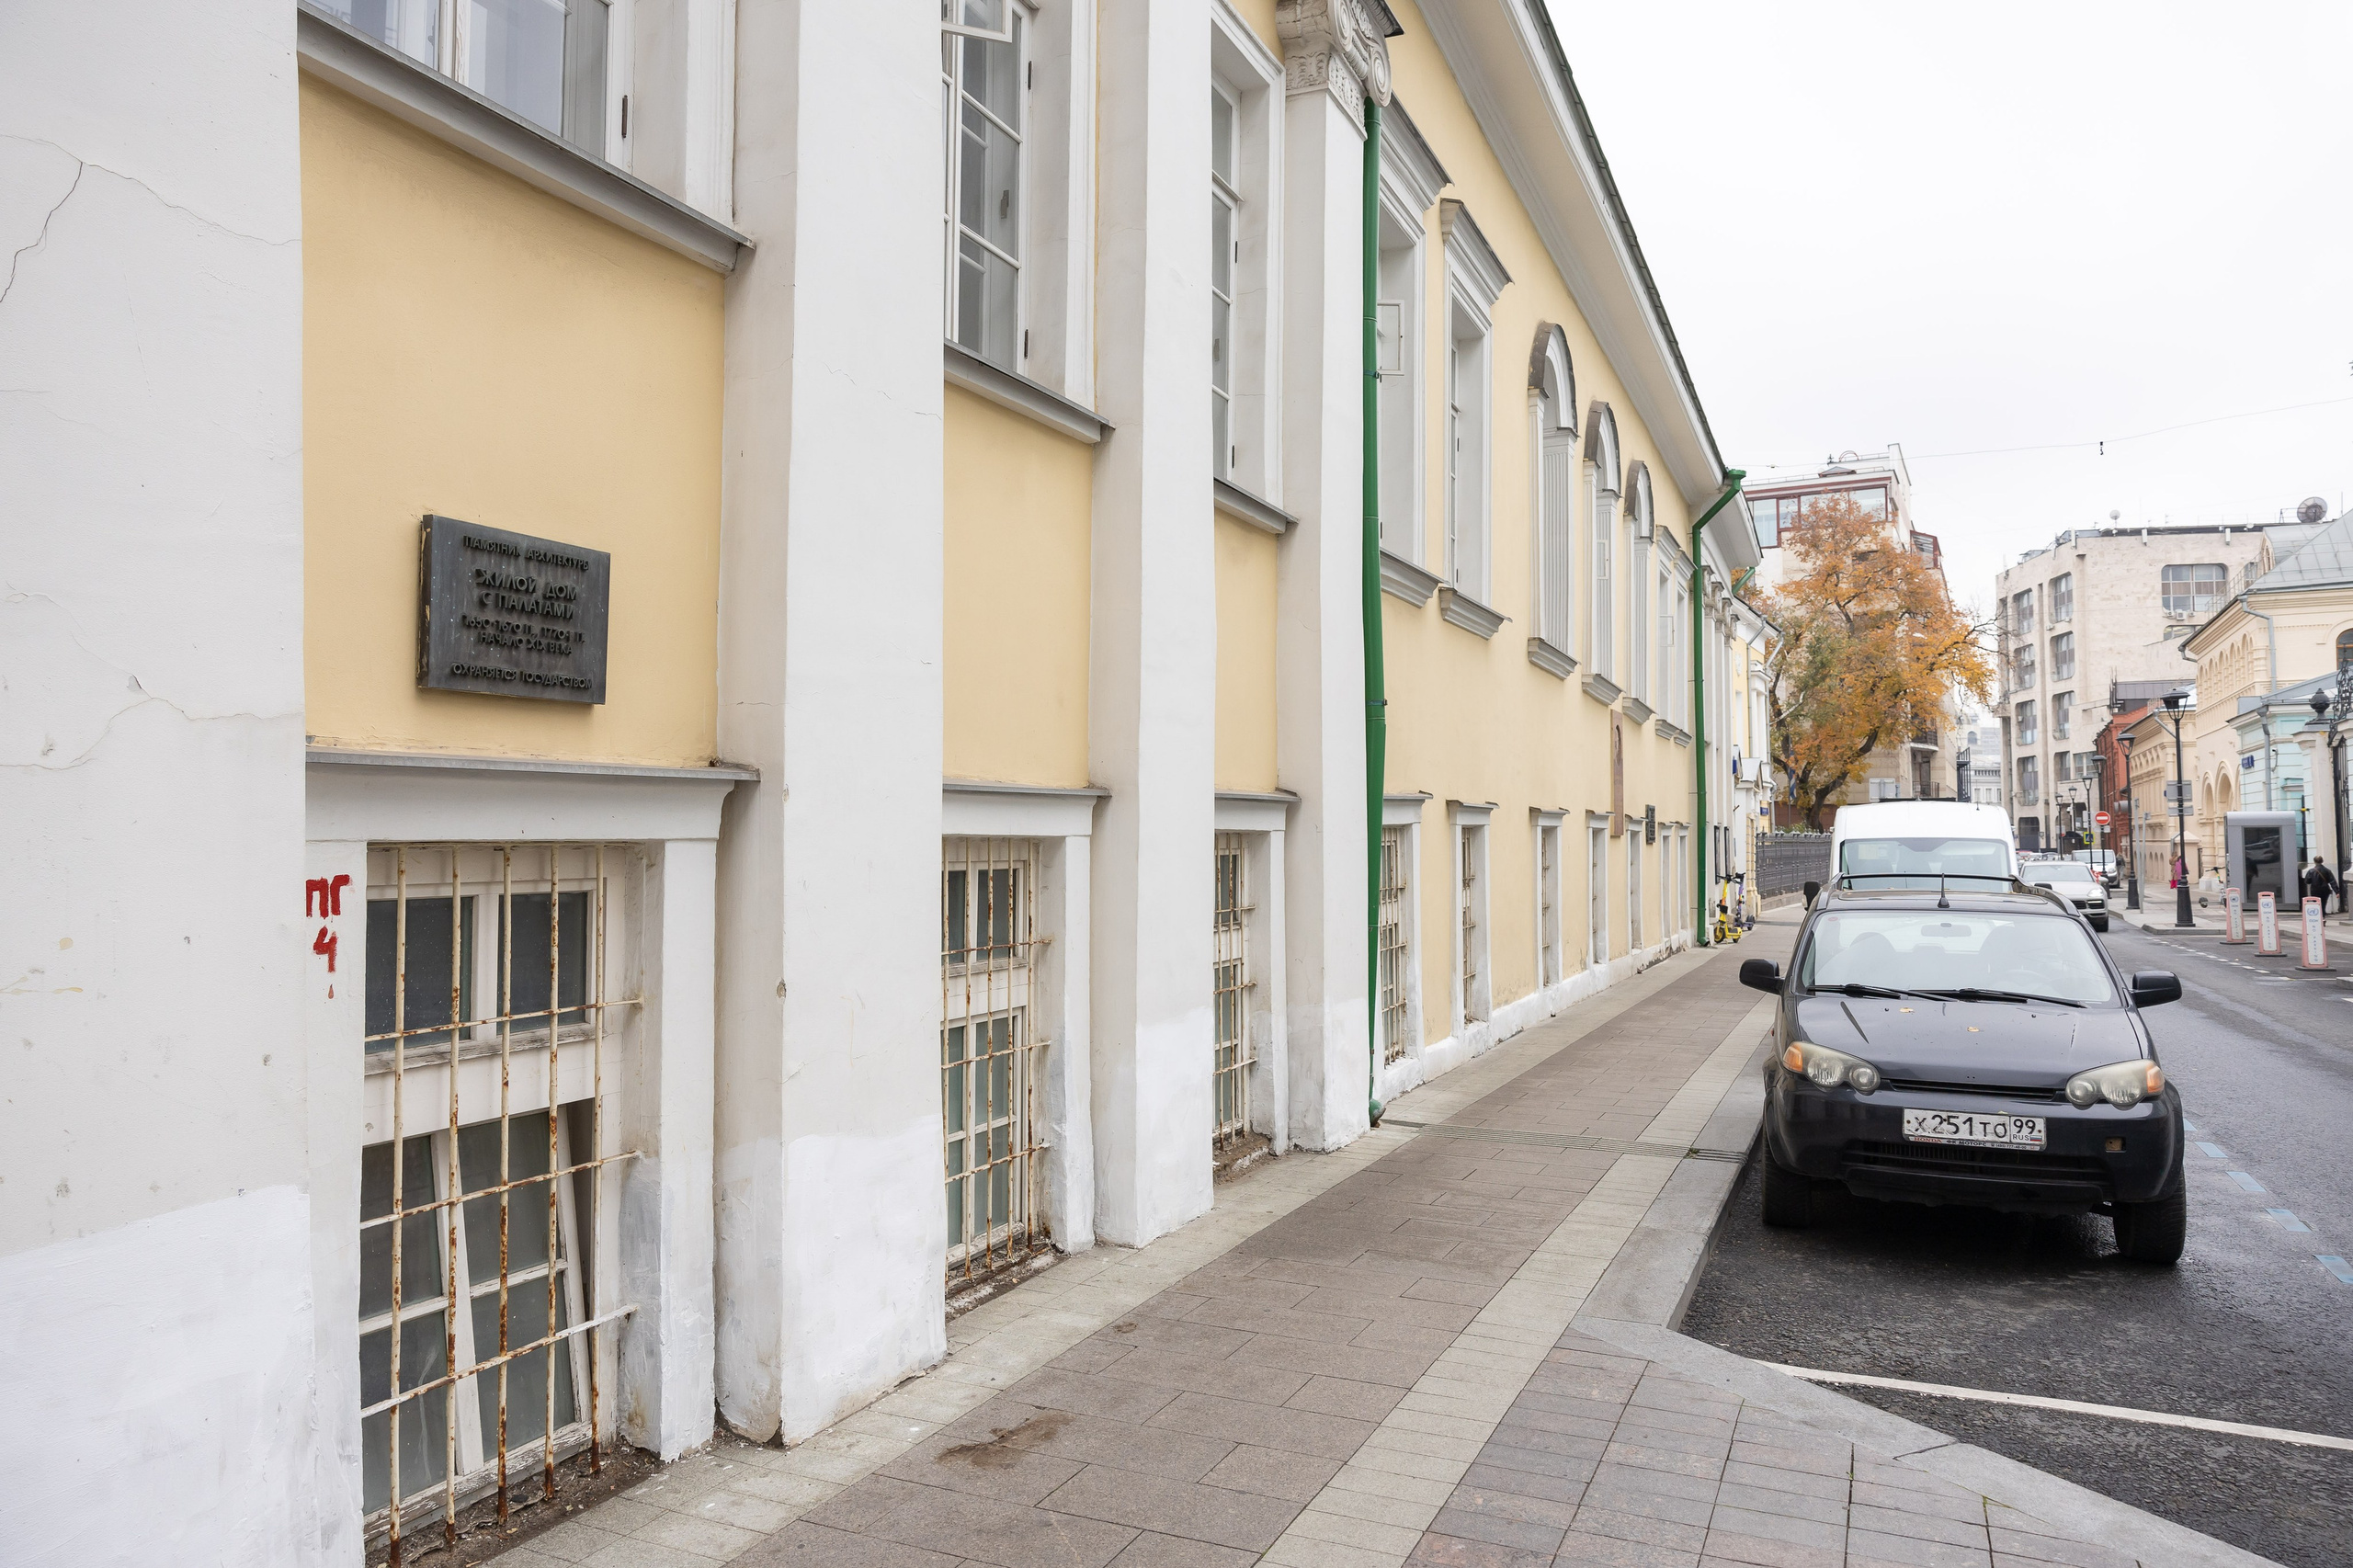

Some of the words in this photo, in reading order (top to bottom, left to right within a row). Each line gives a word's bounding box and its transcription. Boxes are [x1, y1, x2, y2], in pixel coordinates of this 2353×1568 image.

[464, 535, 521, 558] ПАМЯТНИК
[475, 568, 537, 593] ЖИЛОЙ
[543, 581, 578, 602] ДОМ
[480, 590, 493, 607] С
[495, 592, 576, 619] ПАЛАТАМИ
[478, 631, 524, 648] НАЧАЛО
[549, 641, 573, 654] ВЕКА
[451, 662, 517, 680] ОХРАНЯЕТСЯ
[519, 670, 594, 689] ГОСУДАРСТВОМ
[313, 925, 338, 973] 4
[2012, 1133, 2029, 1142] RUS
[2013, 1118, 2037, 1135] 99
[1914, 1136, 1942, 1144] HONDA
